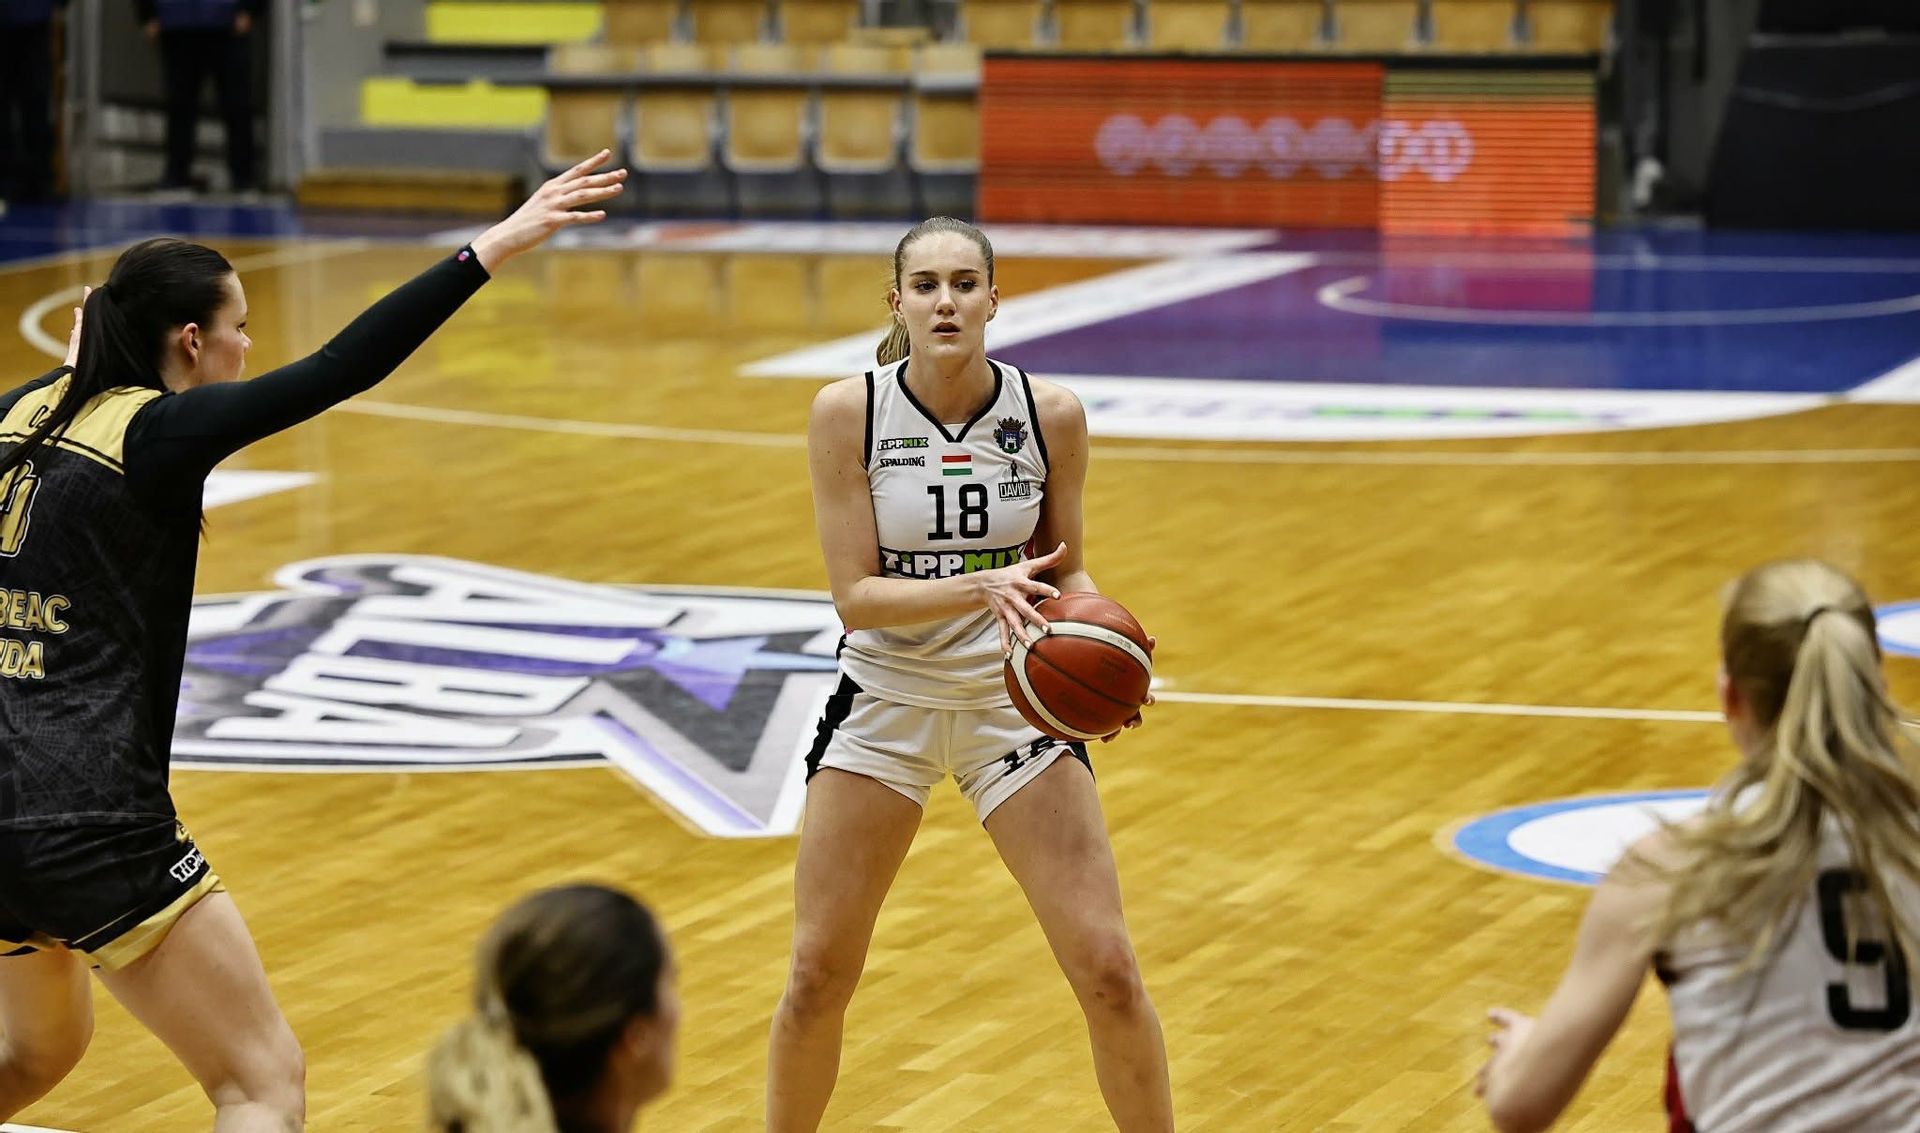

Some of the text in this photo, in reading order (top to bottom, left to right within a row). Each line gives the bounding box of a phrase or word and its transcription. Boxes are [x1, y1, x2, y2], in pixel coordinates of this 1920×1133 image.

[880, 456, 925, 468] SPALDING
[999, 482, 1027, 498] DAVID
[927, 483, 989, 541] 18
[205, 563, 687, 748] ALBA
[1817, 867, 1912, 1032] 9
